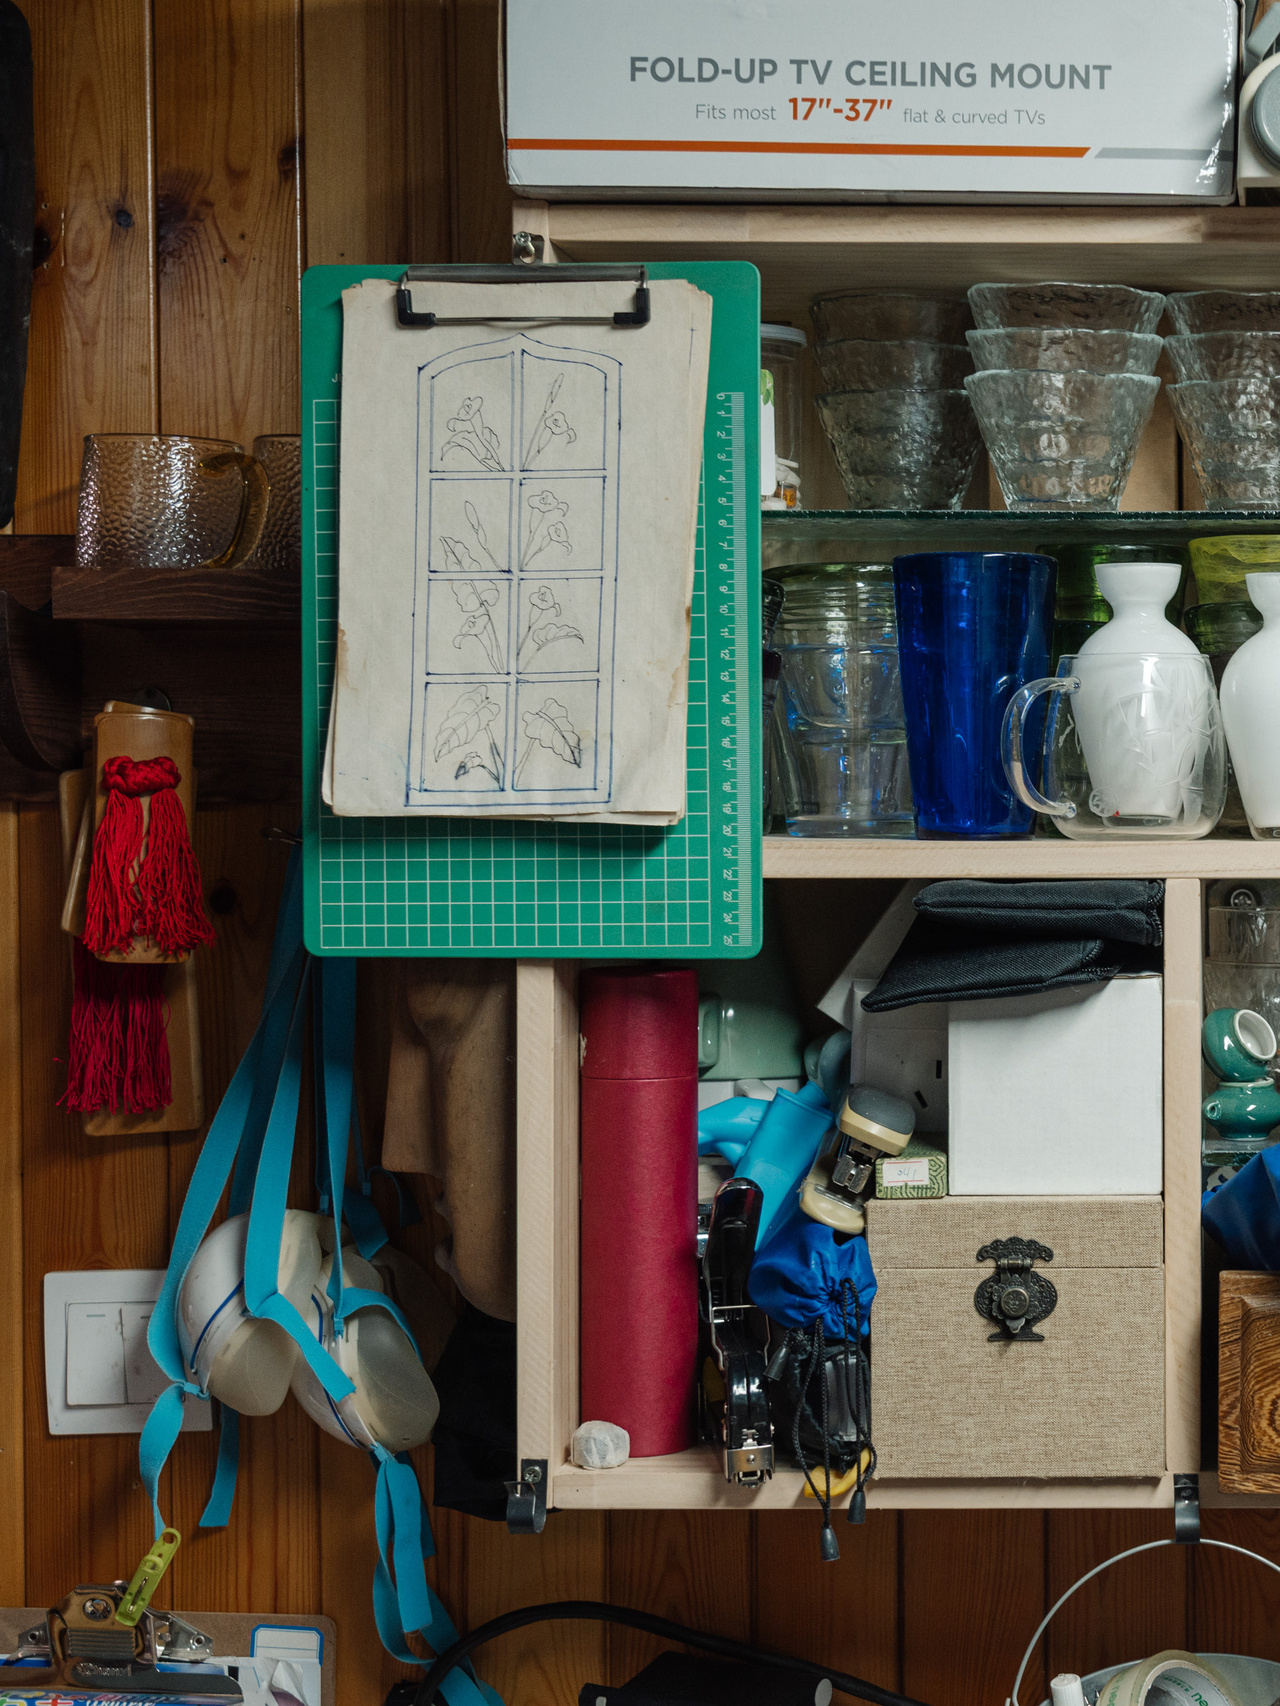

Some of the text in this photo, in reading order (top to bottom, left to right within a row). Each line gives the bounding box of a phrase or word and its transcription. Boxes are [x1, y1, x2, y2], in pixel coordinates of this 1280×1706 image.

[630, 56, 1112, 90] FOLD-UP TV CEILING MOUNT
[695, 103, 727, 120] Fits
[733, 105, 777, 121] most
[903, 107, 929, 124] flat
[934, 109, 946, 124] &
[952, 109, 1008, 125] curved
[1014, 109, 1046, 125] TVs
[717, 430, 726, 438] 2
[718, 474, 727, 482] 4
[720, 604, 729, 614] 10
[720, 627, 729, 637] 11
[720, 649, 730, 659] 12
[720, 670, 730, 681] 13
[721, 692, 731, 703] 14
[721, 715, 731, 726] 15
[722, 736, 731, 748] 16
[722, 758, 731, 769] 17
[722, 781, 732, 792] 18
[722, 802, 732, 813] 19
[723, 824, 732, 836] 20
[723, 869, 733, 880] 22
[723, 891, 733, 902] 23
[724, 913, 733, 924] 24
[724, 935, 733, 946] 25
